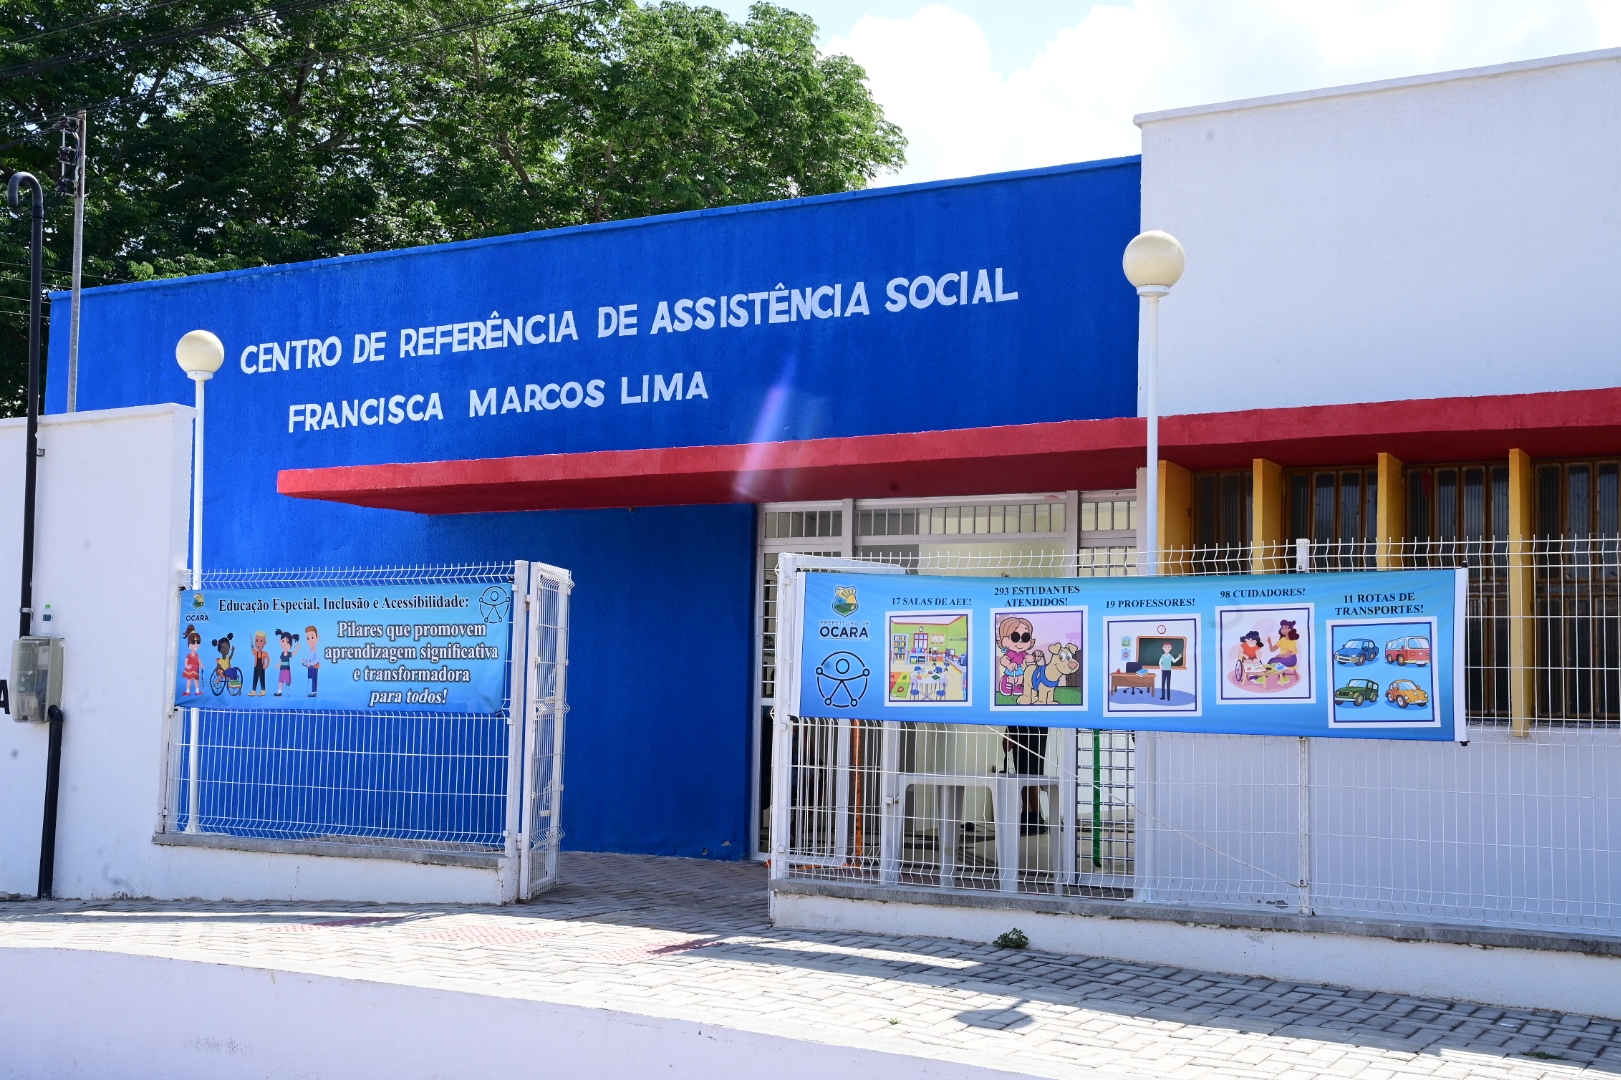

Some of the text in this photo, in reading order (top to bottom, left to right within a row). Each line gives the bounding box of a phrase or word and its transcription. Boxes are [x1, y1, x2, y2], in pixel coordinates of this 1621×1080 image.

[240, 267, 1019, 375] CENTRO DE REFERÊNCIA DE ASSISTÊNCIA SOCIAL
[288, 371, 709, 433] FRANCISCA MARCOS LIMA
[994, 585, 1080, 596] 293 ESTUDANTES
[1219, 587, 1306, 599] 98 CUIDADORES!
[218, 595, 469, 613] Educação Especial, Inclusão e Acessibilidade:
[891, 597, 972, 606] 17 SALAS DE AEE!
[1004, 597, 1069, 607] ATENDIDOS!
[1105, 598, 1196, 608] 19 PROFESSORES!
[1343, 592, 1415, 604] 11 ROTAS DE
[1334, 604, 1425, 616] TRANSPORTES!
[185, 614, 210, 622] OCARA
[337, 622, 487, 642] Pilares que promovem
[819, 626, 869, 638] OCARA
[324, 643, 498, 662] aprendizagem significativa
[353, 666, 470, 682] e transformadora
[369, 688, 448, 706] para todos!
